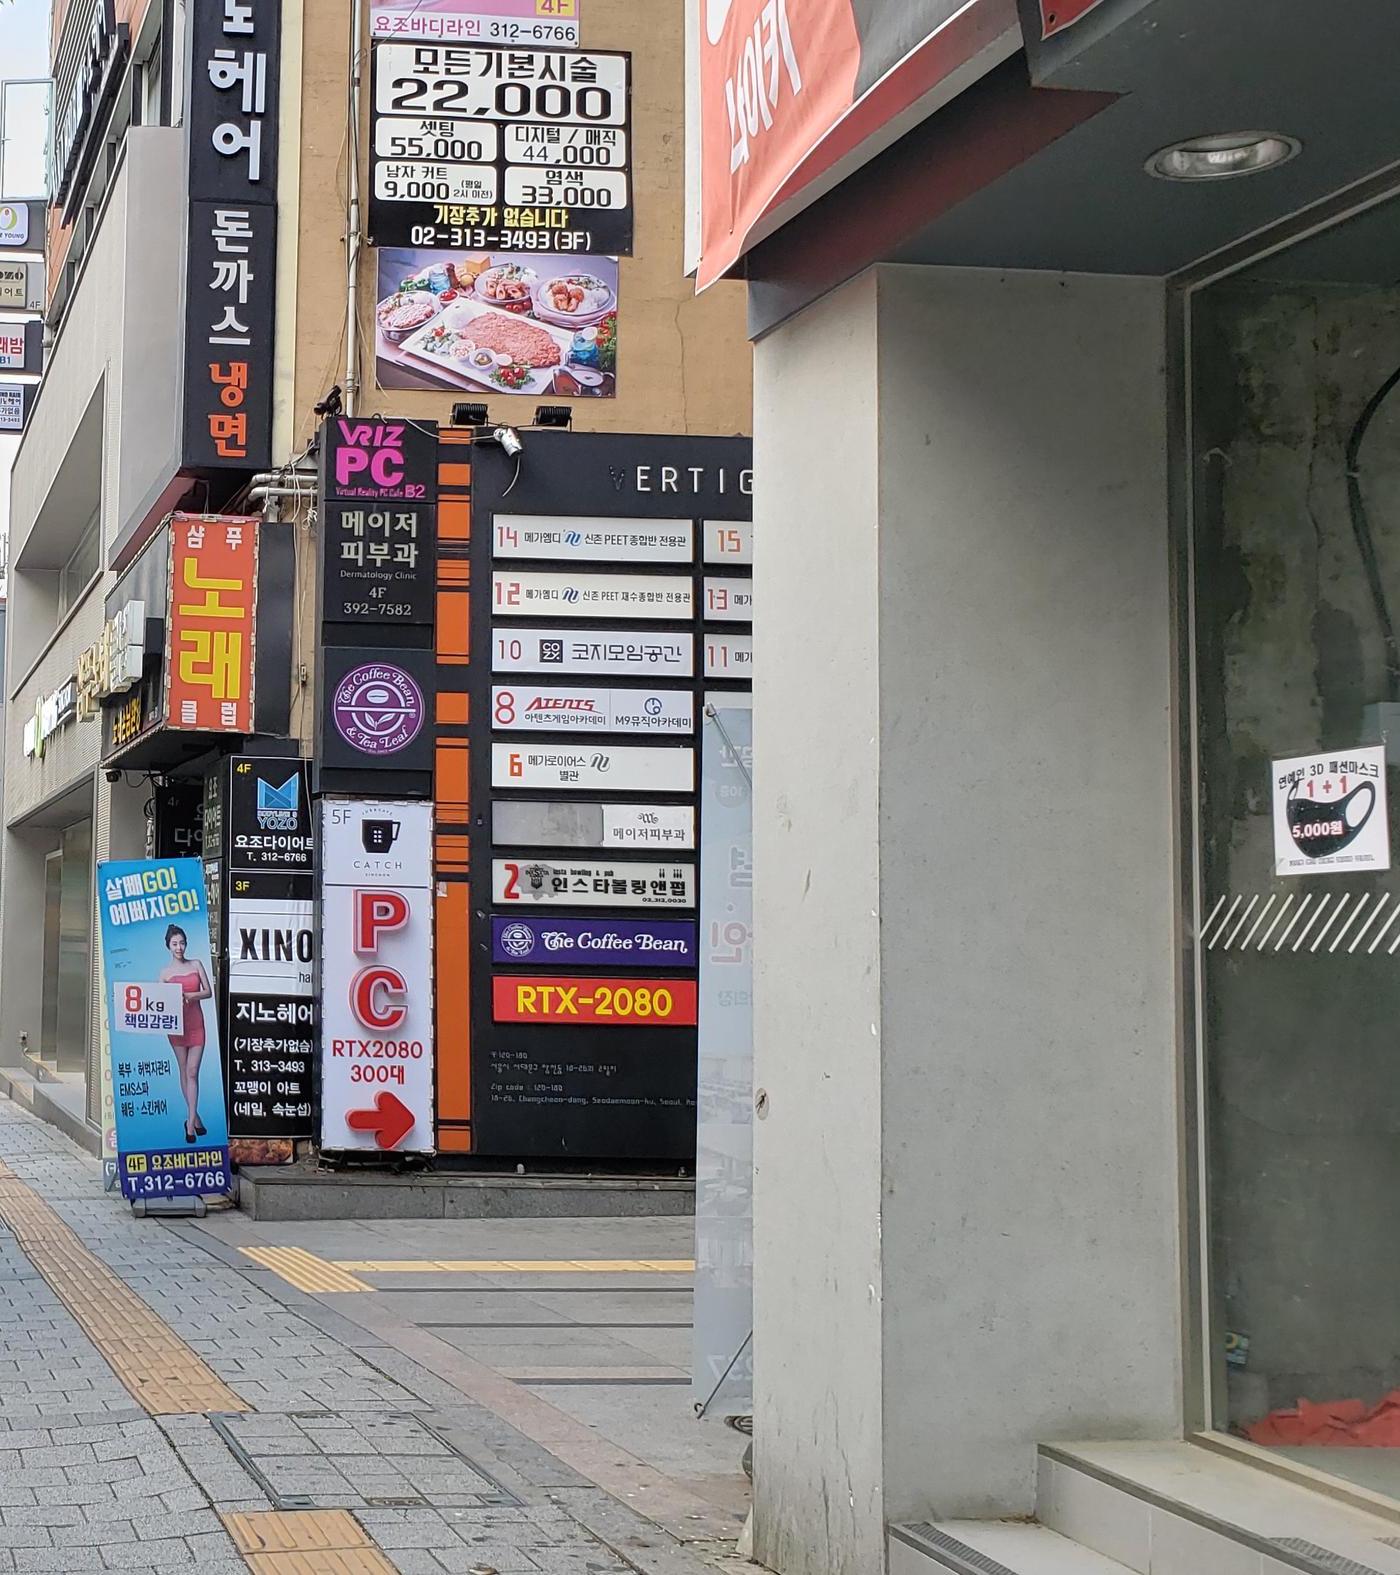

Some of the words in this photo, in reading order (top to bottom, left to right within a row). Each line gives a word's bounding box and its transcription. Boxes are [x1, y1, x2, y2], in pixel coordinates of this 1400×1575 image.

[374, 16, 481, 36] 요조바디라인
[490, 23, 576, 41] 312-6766
[413, 48, 598, 83] 모든기본시술
[391, 78, 612, 121] 22,000
[419, 121, 455, 137] 셋팅
[515, 126, 561, 144] 디지털
[585, 130, 617, 147] 매직
[390, 137, 482, 160] 55,000
[386, 165, 416, 179] 남자
[421, 166, 448, 180] 커트
[545, 170, 584, 186] 염색
[383, 181, 450, 200] 9,000
[453, 189, 471, 199] 2시
[472, 189, 493, 200] 이전)
[521, 185, 611, 207] 33,000
[433, 205, 498, 226] 기장추가
[503, 208, 568, 228] 없습니다
[410, 226, 591, 251] 02-313-3493(3F)
[208, 209, 254, 346] 돈까스
[30, 301, 41, 309] 4F
[0, 356, 11, 364] B1
[208, 362, 248, 458] 냉면
[337, 419, 405, 447] VRIZ
[336, 447, 405, 487] PC
[609, 464, 752, 494] ERTIG
[404, 484, 426, 498] B2
[340, 510, 418, 538] 메이저
[497, 526, 518, 548] 14
[524, 531, 561, 543] 메가엠디
[604, 535, 629, 545] PEET
[630, 535, 657, 547] 종합반
[659, 536, 686, 548] 전용관
[717, 530, 741, 552] 15
[340, 541, 419, 569] 피부과
[340, 569, 394, 581] Dermatology
[394, 571, 417, 580] Clinic
[369, 587, 387, 599] 4F
[495, 582, 520, 606] 12
[601, 591, 619, 601] PEET
[666, 592, 691, 603] 전용관
[707, 589, 728, 610] 13
[343, 603, 412, 616] 392-7582
[178, 557, 245, 699] 노래
[498, 639, 521, 661] 10
[543, 642, 561, 652] CO
[572, 643, 682, 663] 코지모임공간
[708, 646, 728, 668] 11
[338, 683, 355, 704] The
[352, 668, 391, 684] Coffee
[392, 672, 415, 707] Bean
[495, 691, 515, 725] 8
[525, 697, 599, 712] ATENTS
[525, 713, 606, 725] 아텐츠게임아카데미
[615, 716, 692, 729] M9뮤직아카데미
[346, 726, 357, 738] &
[358, 732, 377, 748] Tea
[379, 725, 409, 748] Leaf
[236, 763, 251, 774] 4F
[509, 753, 522, 777] 6
[528, 754, 586, 767] 메가로이어스
[1310, 763, 1323, 777] 3D
[1329, 761, 1379, 778] 패션마스크
[559, 770, 579, 782] 별관
[257, 817, 298, 830] YOZO
[331, 809, 352, 825] 5F
[613, 827, 685, 841] 메이저피부과
[1292, 821, 1343, 838] 5,000원
[247, 852, 257, 862] T.
[261, 852, 307, 862] 312-6766
[353, 861, 402, 870] CATCH
[106, 867, 178, 901] 살빼GO!
[235, 881, 250, 891] 3F
[503, 864, 520, 899] 2
[552, 878, 686, 896] 인스타볼링앤펍
[109, 889, 200, 926] 예뻐지GO!
[239, 928, 313, 963] XINO
[541, 932, 574, 950] The
[577, 932, 633, 950] Coffee
[635, 934, 688, 954] Bean
[349, 889, 411, 1031] PC
[299, 972, 313, 983] ha
[517, 986, 673, 1016] RTX-2080
[125, 1013, 178, 1030] 책임감량!
[236, 1002, 313, 1025] 지노헤어
[332, 1040, 423, 1059] RTX2080
[234, 1060, 246, 1072] T.
[251, 1060, 305, 1072] 313-3493
[350, 1065, 404, 1084] 300대
[120, 1081, 149, 1097] EMS스파
[234, 1082, 271, 1095] 꼬맹이
[277, 1082, 300, 1095] 아트
[234, 1102, 266, 1116] (네일,
[128, 1156, 145, 1171] 4F
[151, 1151, 222, 1171] 요조바디라인
